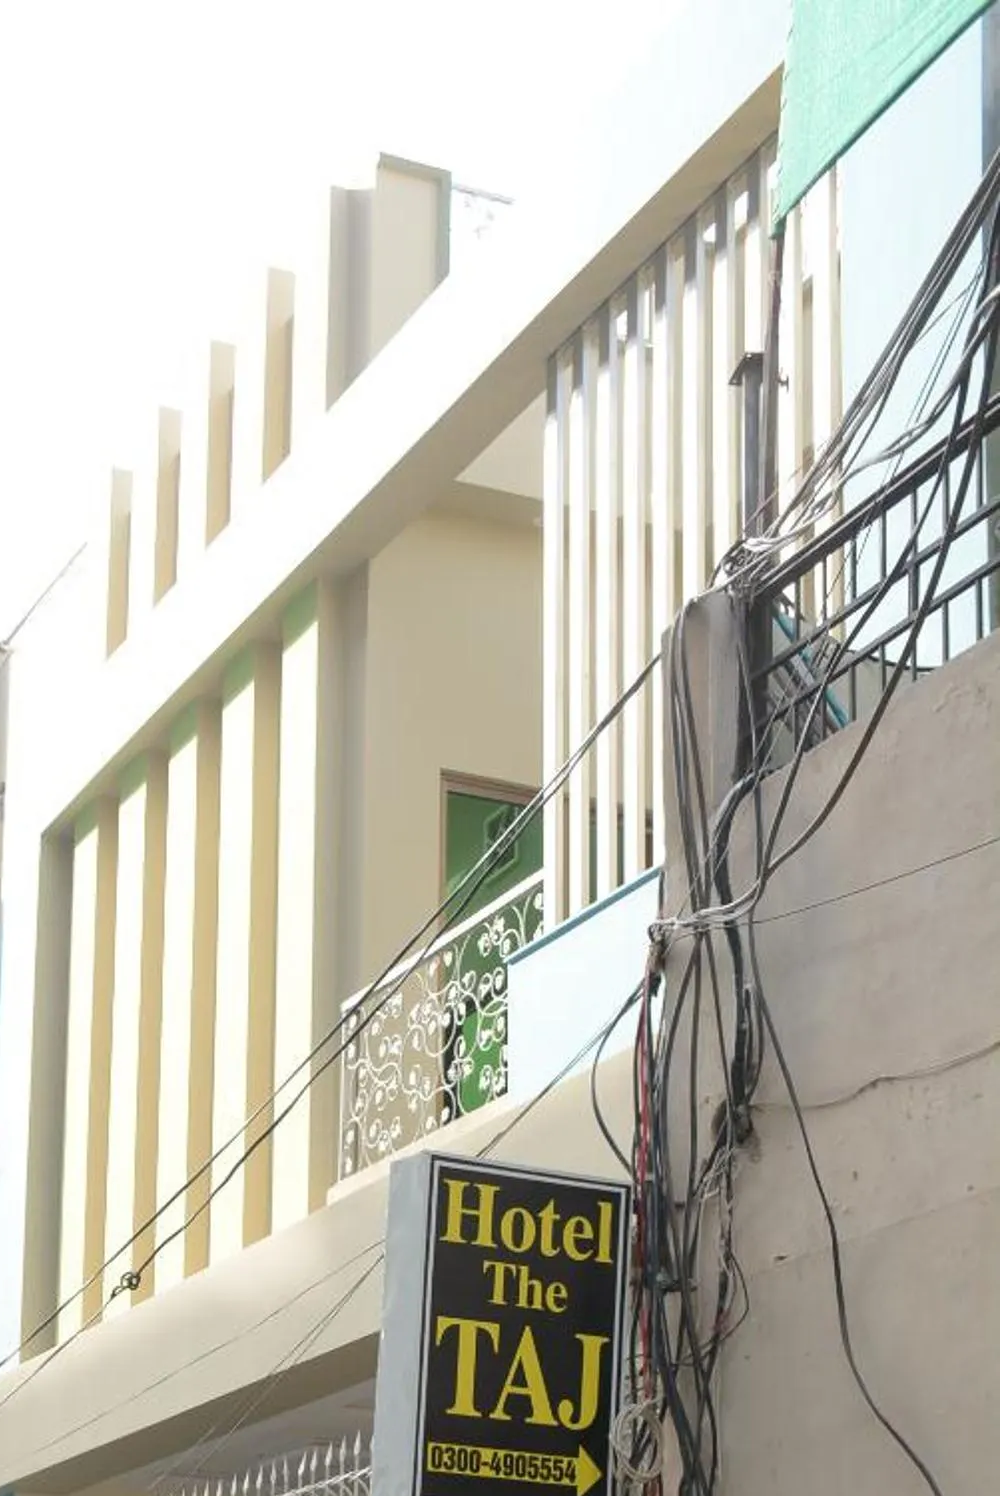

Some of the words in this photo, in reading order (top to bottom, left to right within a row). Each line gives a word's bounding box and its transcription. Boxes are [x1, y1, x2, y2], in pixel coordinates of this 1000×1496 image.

[439, 1178, 614, 1264] Hotel
[482, 1259, 569, 1314] The
[435, 1315, 610, 1431] TAJ
[431, 1445, 577, 1484] 0300-4905554
